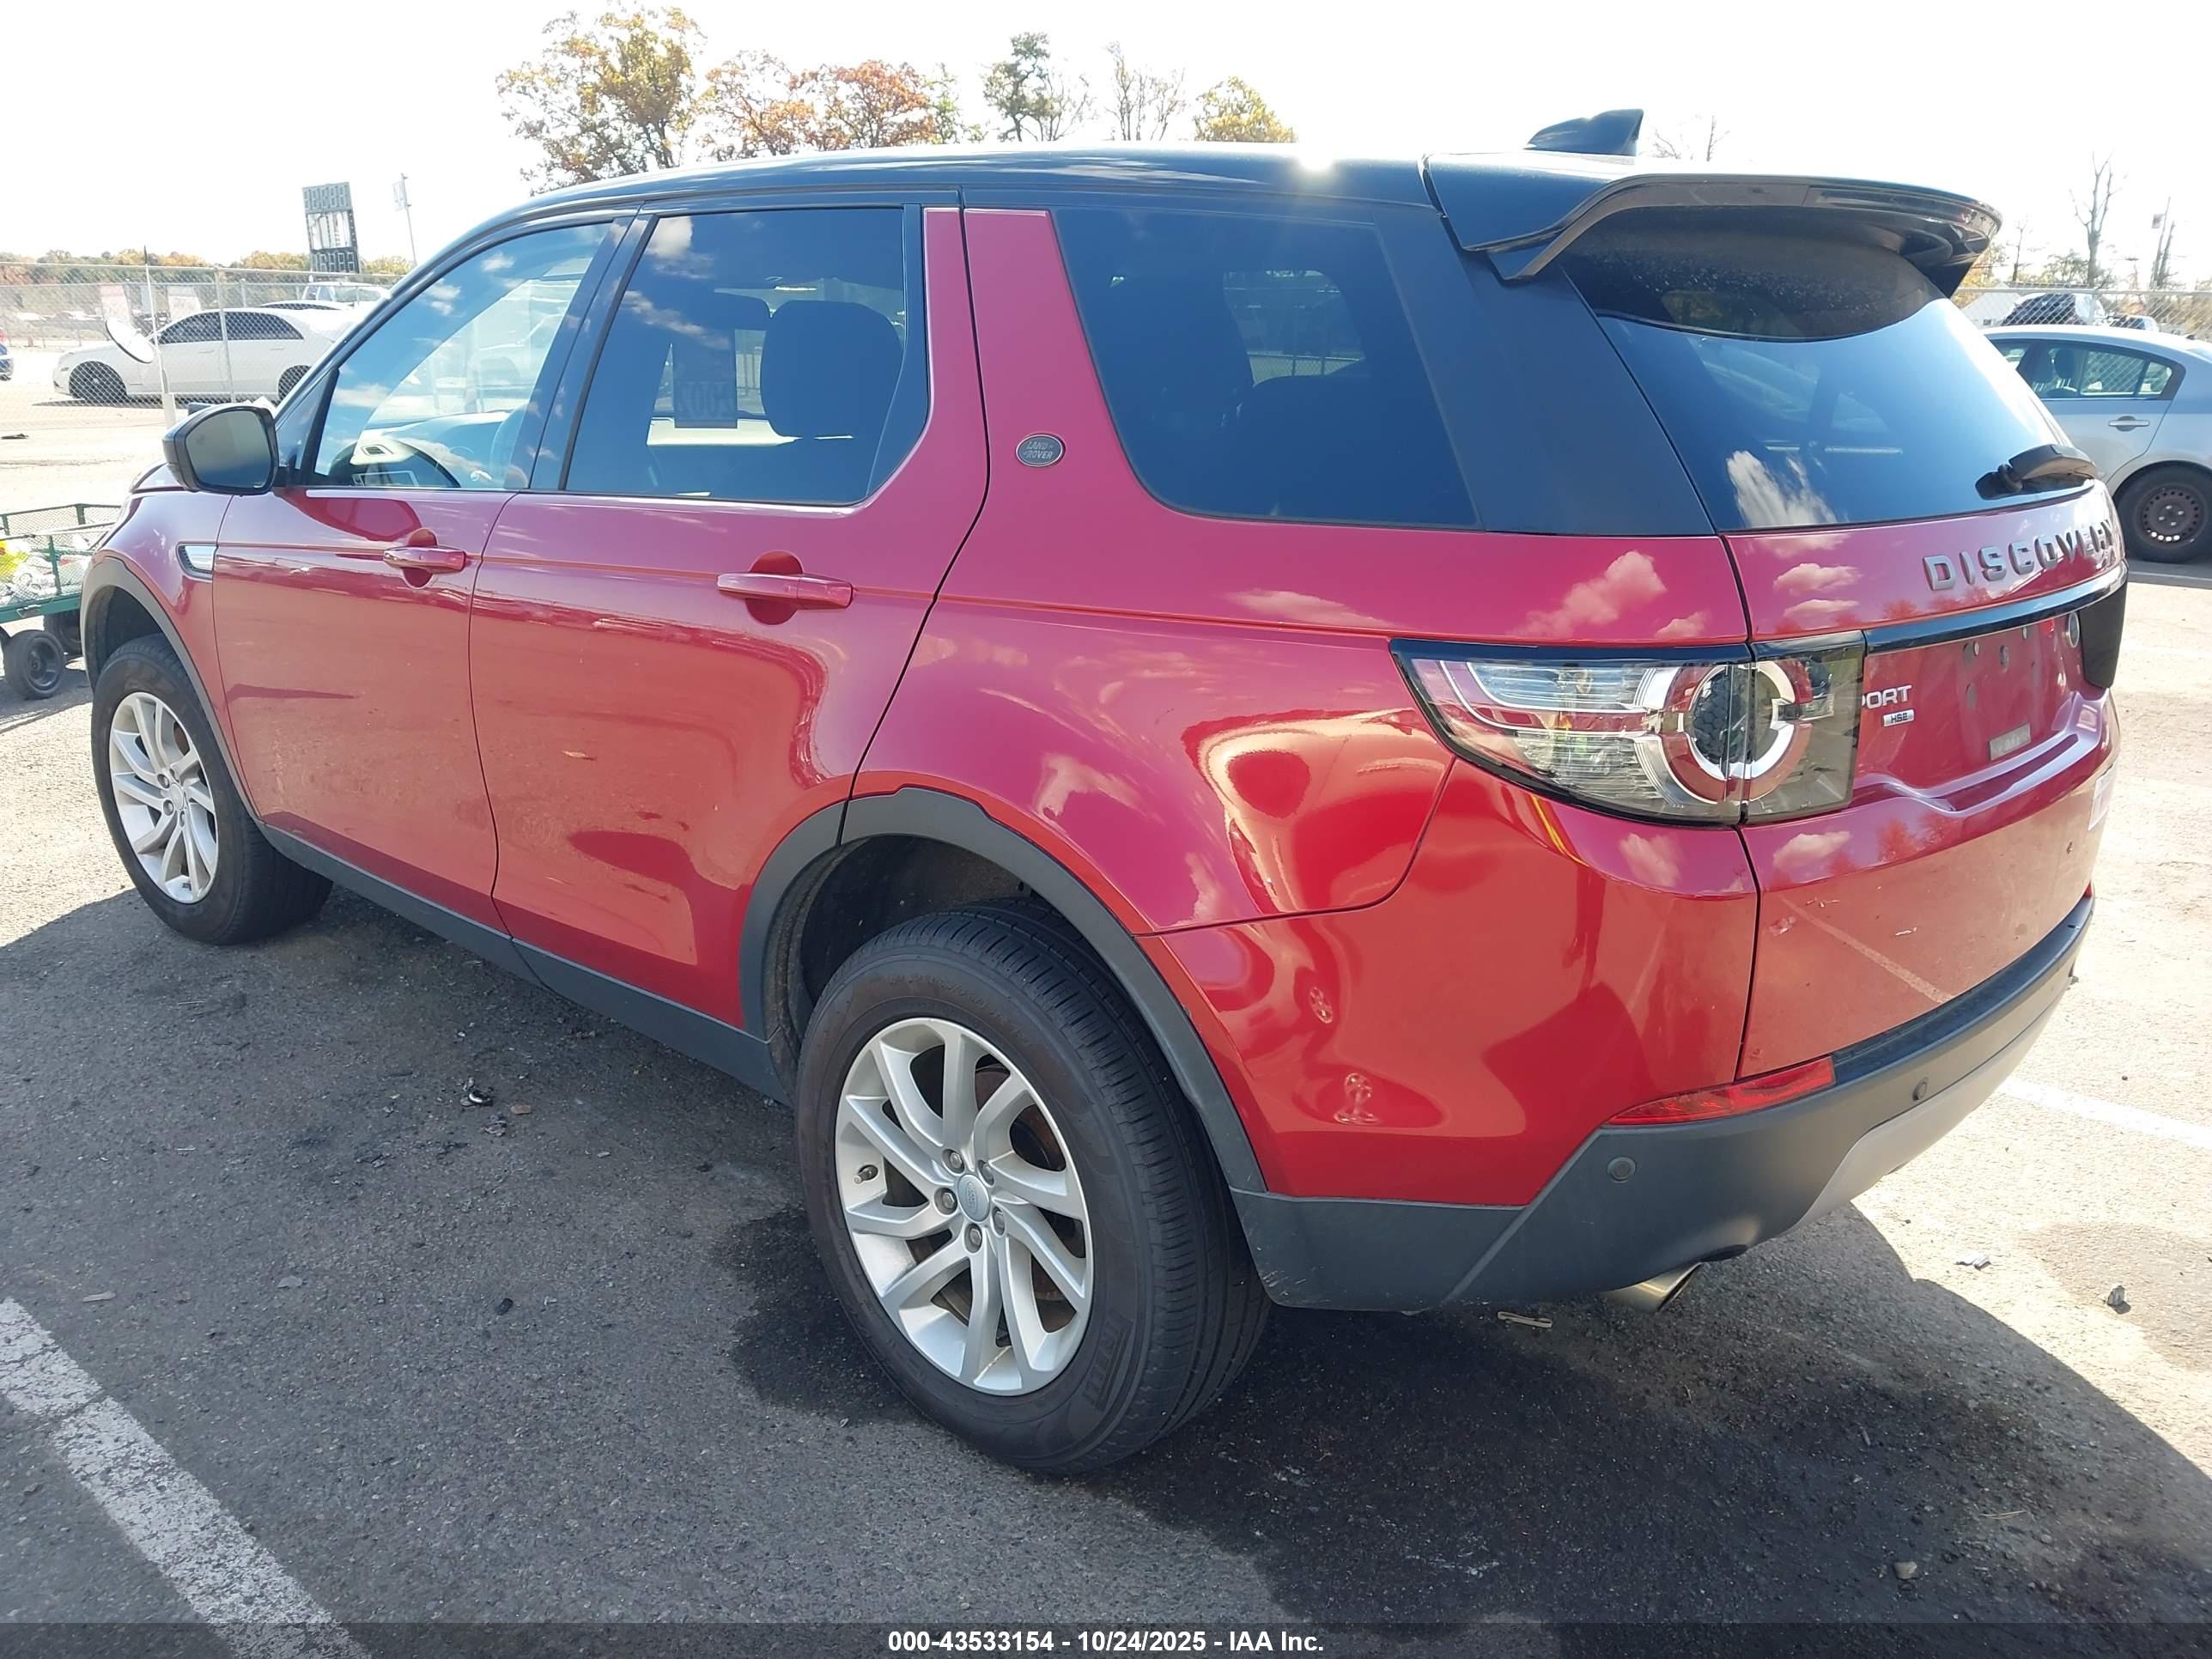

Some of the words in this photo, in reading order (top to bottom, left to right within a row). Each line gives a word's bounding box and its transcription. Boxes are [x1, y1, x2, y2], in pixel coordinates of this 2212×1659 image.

[1026, 441, 1048, 450] LAND
[1026, 450, 1054, 459] ROVER
[1923, 519, 2115, 591] DISCOVERY
[1890, 712, 1908, 724] HSE
